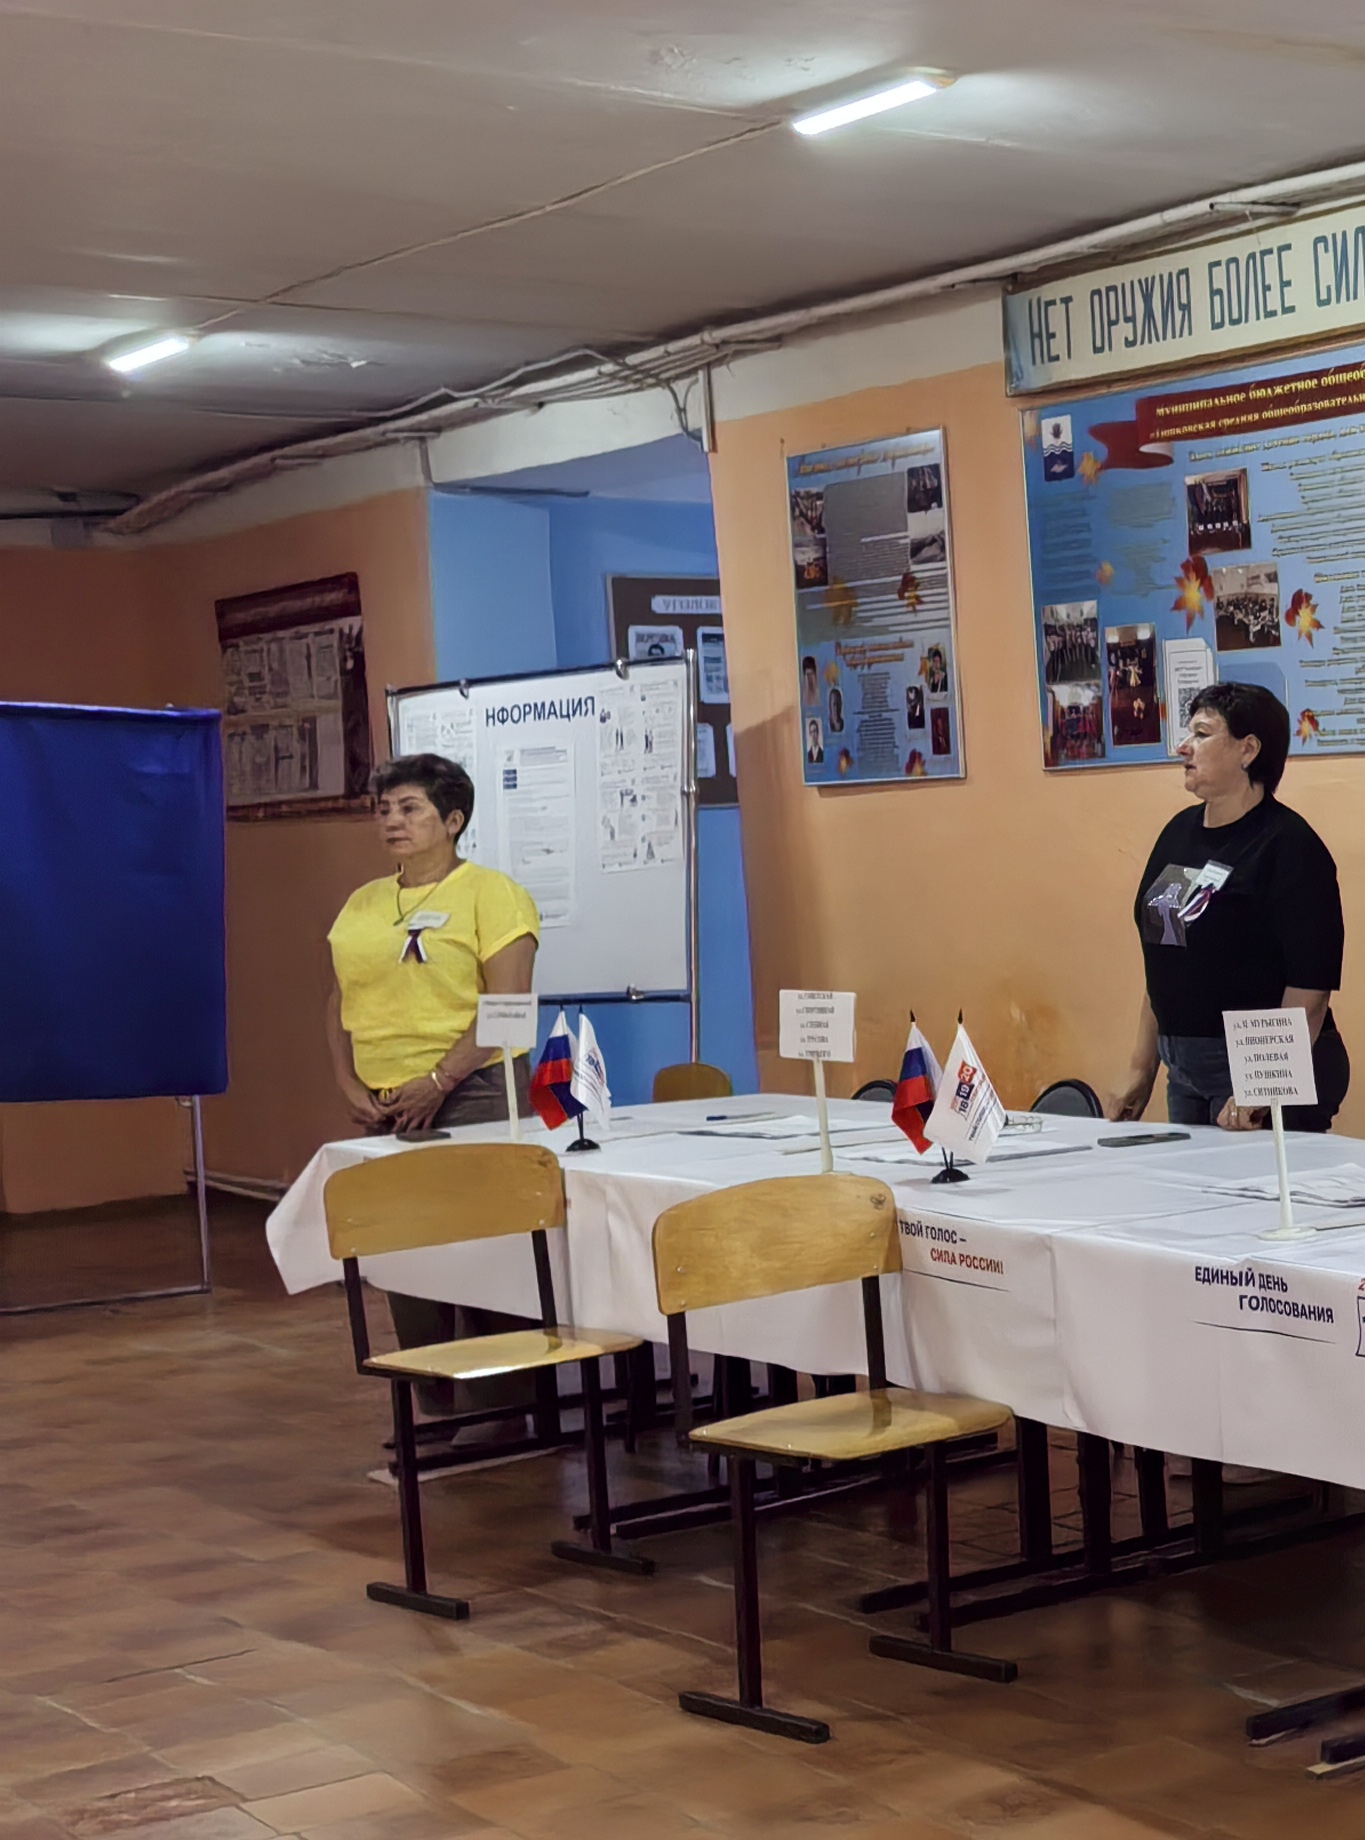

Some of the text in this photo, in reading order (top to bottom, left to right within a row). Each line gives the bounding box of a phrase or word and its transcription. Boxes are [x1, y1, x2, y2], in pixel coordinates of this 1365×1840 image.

[1028, 295, 1073, 366] НЕТ
[1090, 267, 1193, 355] ОРУЖИЯ
[1208, 243, 1296, 331] БОЛЕЕ
[899, 1219, 923, 1238] ТВОЙ
[925, 1225, 958, 1244] ГОЛОС
[930, 1247, 1004, 1275] СИЛА РОССИИ!
[1194, 1265, 1289, 1293] ЕДИНЫЙ ДЕНЬ
[1238, 1295, 1335, 1324] ГОЛОСОВАНИЯ
